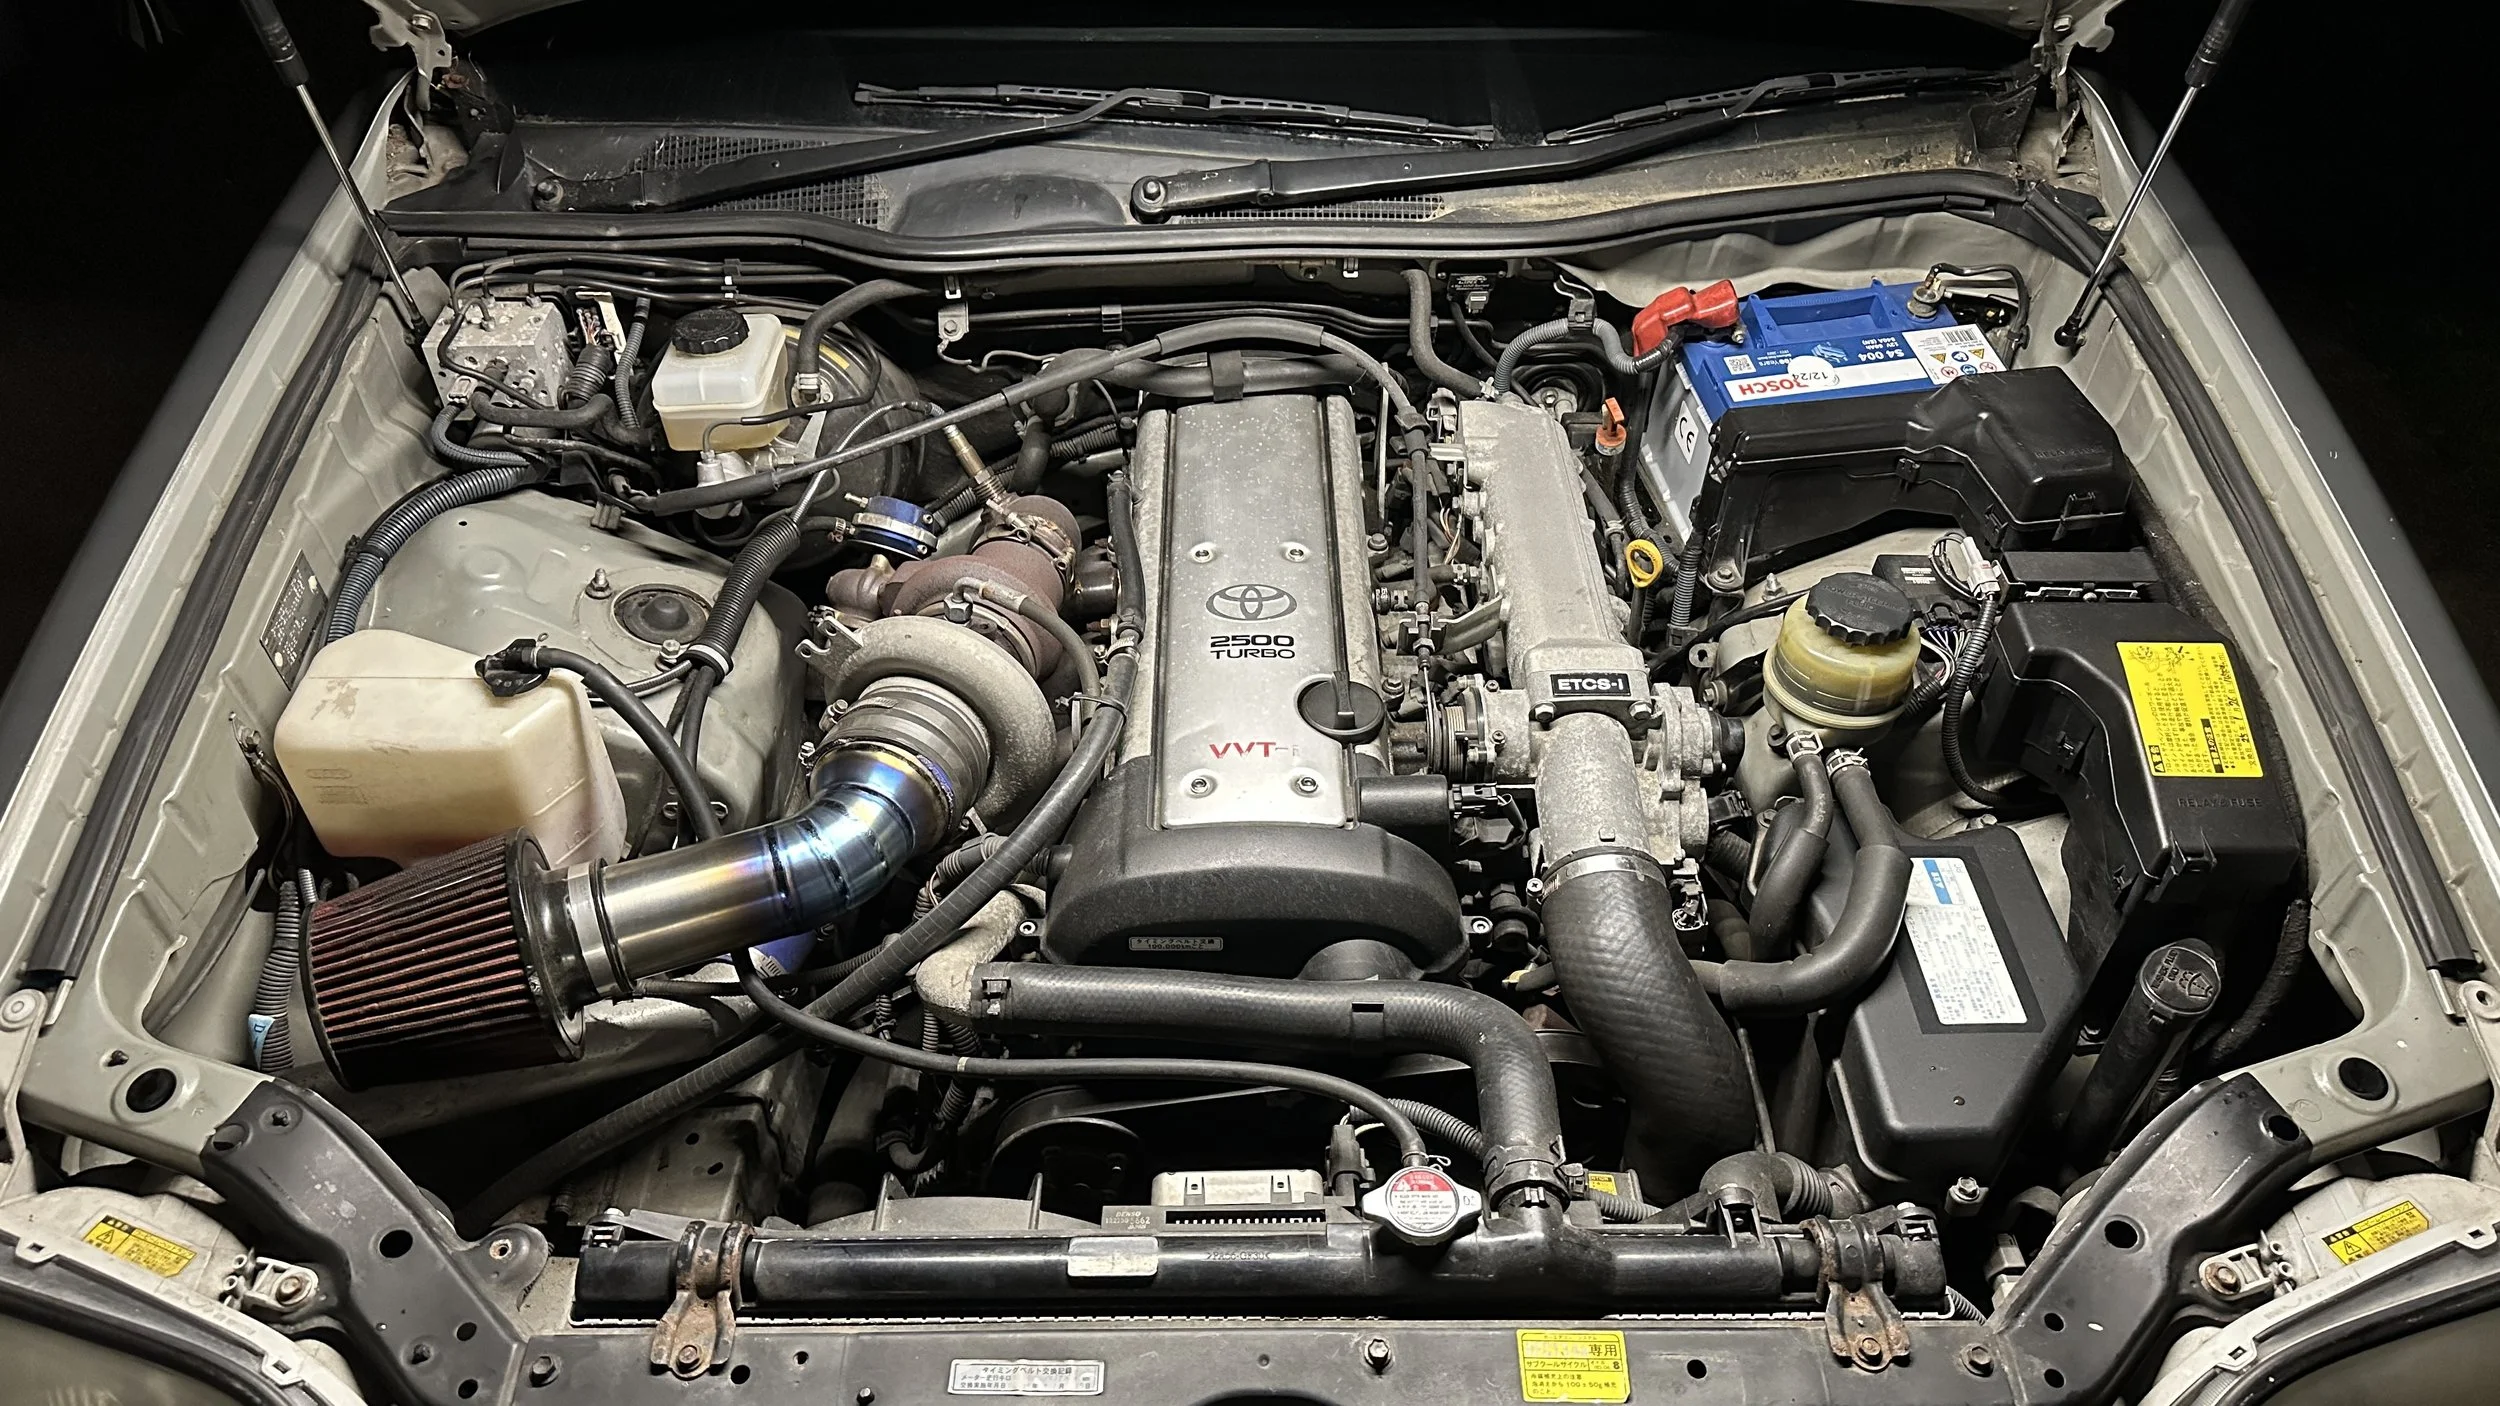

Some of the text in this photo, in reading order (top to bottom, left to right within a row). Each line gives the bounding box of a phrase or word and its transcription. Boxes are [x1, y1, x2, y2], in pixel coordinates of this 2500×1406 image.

[1858, 349, 1905, 361] S4 004
[1210, 634, 1295, 648] 2500
[1210, 648, 1296, 660] TURBO
[1588, 1344, 1618, 1357] 専用
[1526, 1360, 1588, 1368] サブクールサイクル
[982, 1366, 1073, 1375] タイミングベルト交換記録
